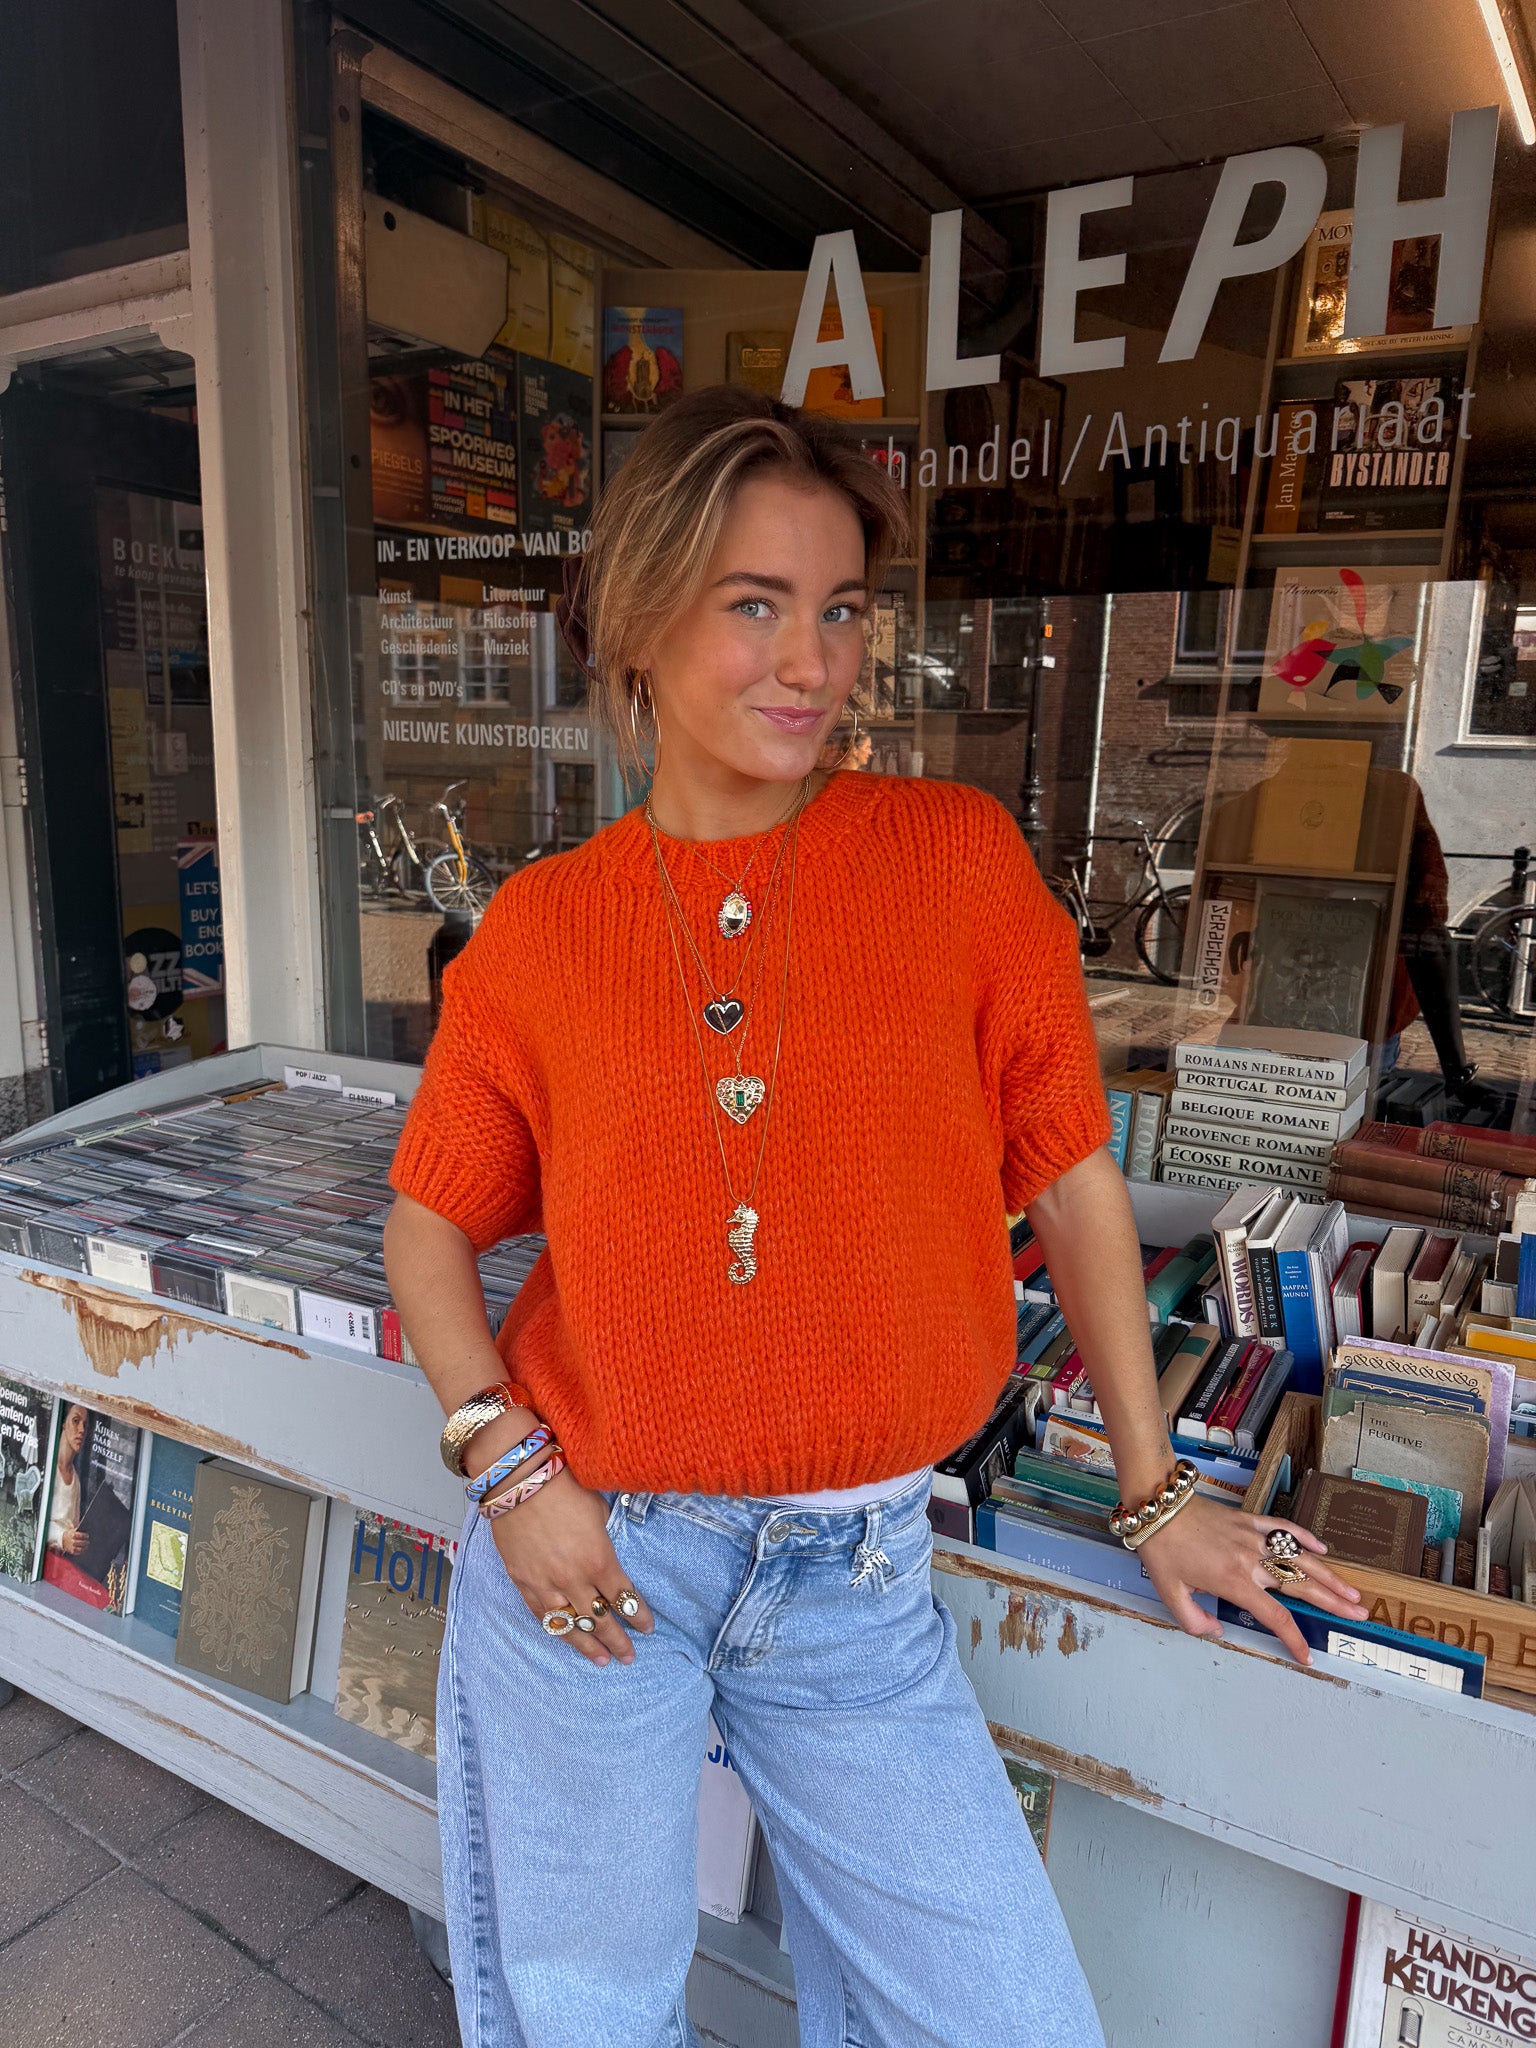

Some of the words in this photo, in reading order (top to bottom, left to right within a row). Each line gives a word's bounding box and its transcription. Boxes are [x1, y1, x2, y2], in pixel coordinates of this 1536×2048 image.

[780, 104, 1499, 408] ALEPH
[443, 390, 461, 410] IN
[464, 396, 493, 419] HET
[430, 425, 516, 463] SPOORWEG
[862, 388, 1476, 490] handel/Antiquariaat
[453, 449, 516, 480] MUSEUM
[1329, 451, 1450, 487] BYSTANDER
[1275, 479, 1296, 511] Jan
[377, 539, 401, 563] IN-
[407, 538, 429, 562] EN
[435, 534, 516, 560] VERKOOP
[522, 530, 560, 557] VAN
[379, 588, 412, 604] Kunst
[482, 586, 546, 602] Literatuur
[380, 614, 454, 630] Architectuur
[483, 613, 537, 629] Filosofie
[380, 639, 459, 655] Geschiedenis
[484, 639, 530, 656] Muziek
[382, 680, 407, 696] CD's
[411, 684, 424, 696] en
[430, 681, 464, 697] DVD's
[383, 719, 450, 745] NIEUWE
[456, 722, 589, 751] KUNSTBOEKEN
[186, 882, 219, 896] LET'S
[191, 908, 218, 923] BUY
[295, 1070, 308, 1078] POP
[312, 1073, 327, 1081] JAZZ
[1185, 1054, 1248, 1071] ROMAANS
[1251, 1062, 1335, 1081] NEDERLAND
[1187, 1073, 1267, 1094] PORTUGAL
[1275, 1085, 1337, 1102] ROMAN
[1181, 1101, 1255, 1121] BELGIQUE
[1262, 1112, 1330, 1132] ROMANE
[1170, 1125, 1250, 1146] PROVENCE
[1256, 1138, 1326, 1158] ROMANE
[1170, 1144, 1232, 1169] ÉCOSSE
[1239, 1158, 1323, 1184] ROMANE
[1232, 1257, 1254, 1324] WORDS
[1245, 1324, 1253, 1333] AT
[1261, 1258, 1278, 1329] HANDBOEK
[1, 1424, 13, 1437] en
[13, 1425, 39, 1449] Terras
[1369, 1417, 1389, 1428] THE
[94, 1433, 112, 1449] NAAR
[1368, 1428, 1423, 1449] FUGITIVE
[92, 1444, 123, 1463] ONSZELF
[354, 1519, 445, 1605] Holl
[1369, 1597, 1495, 1662] Aleph
[1467, 2021, 1515, 2048] SUSAN
